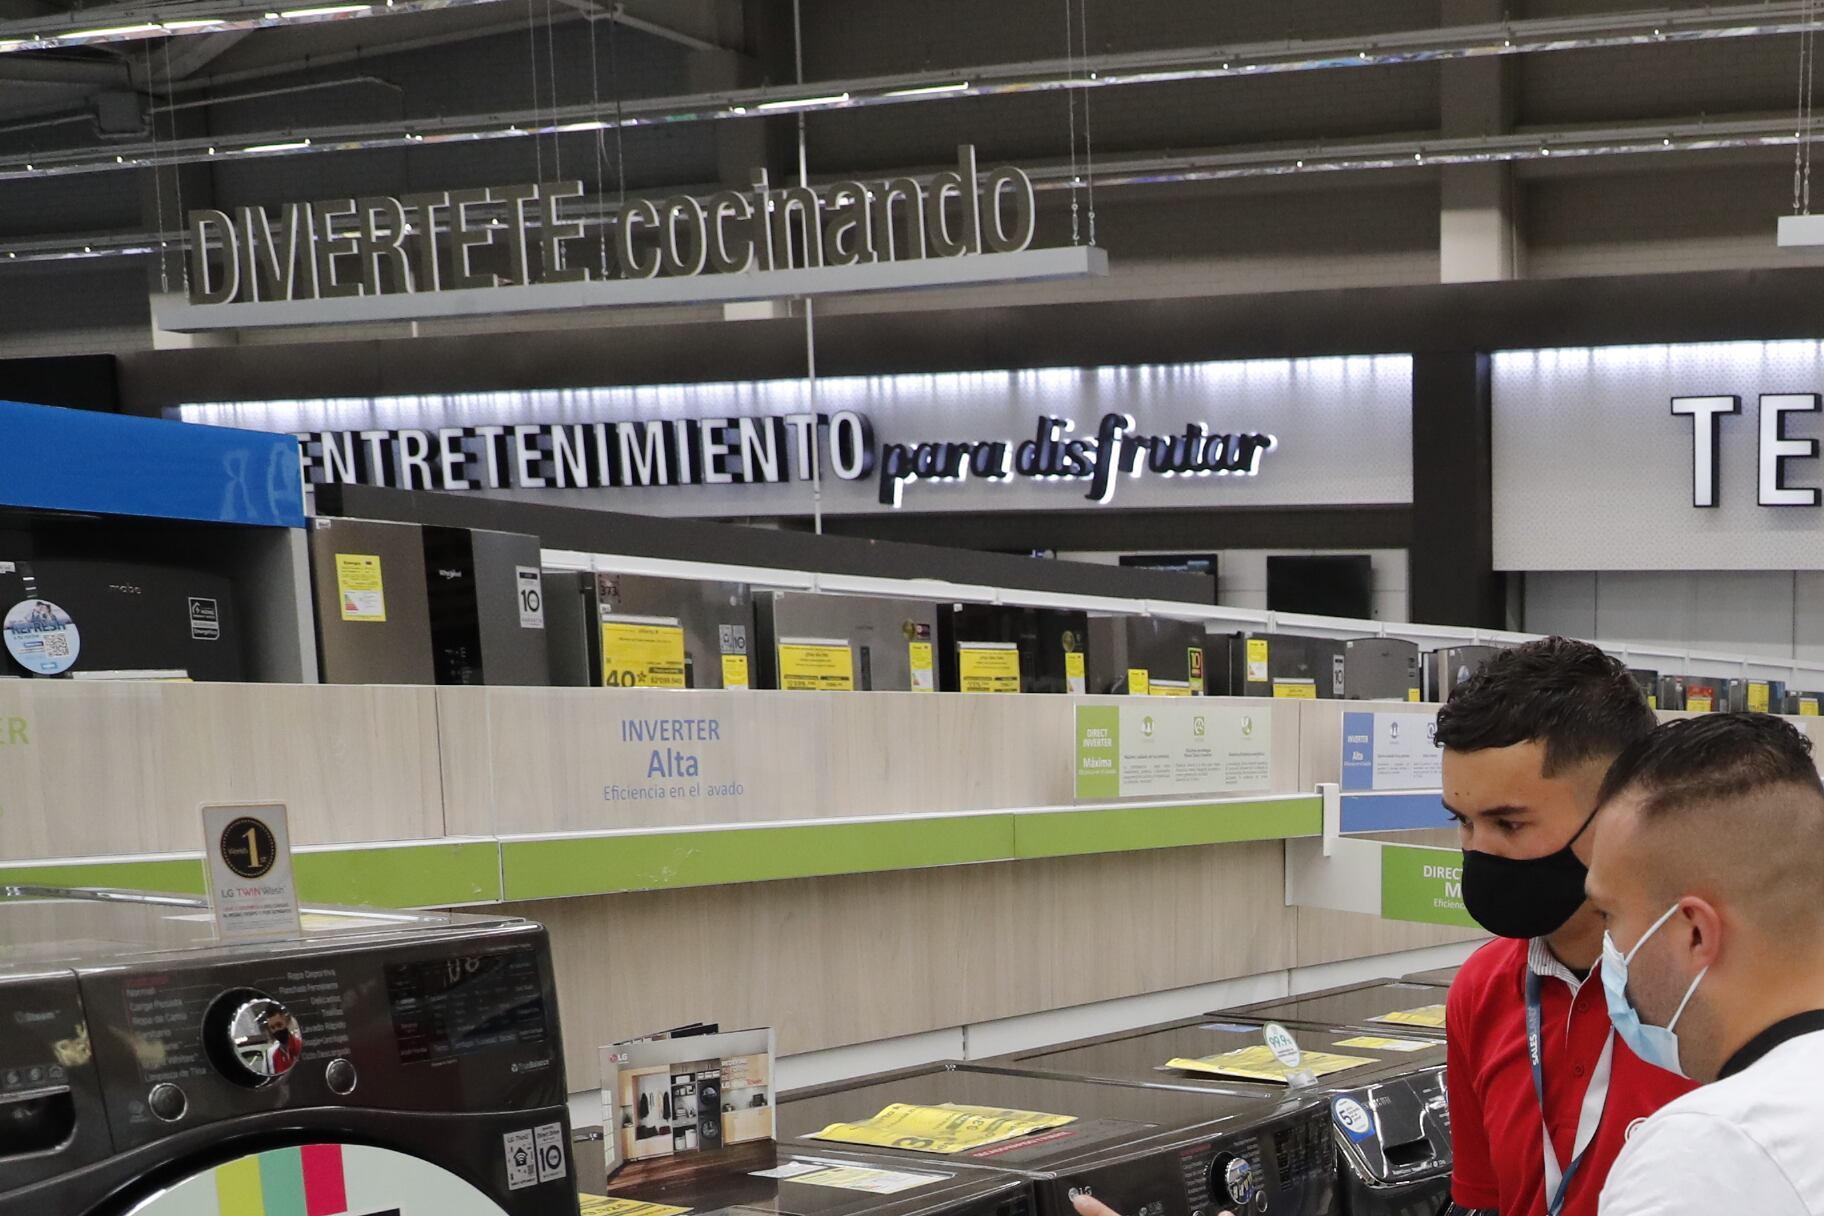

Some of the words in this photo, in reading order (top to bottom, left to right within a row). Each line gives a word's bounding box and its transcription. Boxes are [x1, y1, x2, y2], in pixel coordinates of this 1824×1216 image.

[188, 180, 590, 305] DIVERTETE
[616, 144, 1035, 281] cocinando
[878, 438, 1013, 509] para
[1014, 412, 1277, 503] disfrutar
[521, 589, 539, 613] 10
[621, 719, 721, 742] INVERTER
[647, 748, 699, 778] Alta
[603, 784, 666, 801] Eficiencia
[669, 784, 686, 798] en
[1424, 865, 1462, 880] DIREC
[1433, 897, 1467, 910] Eficienc
[1338, 1110, 1353, 1126] 5
[540, 1144, 562, 1173] 10
